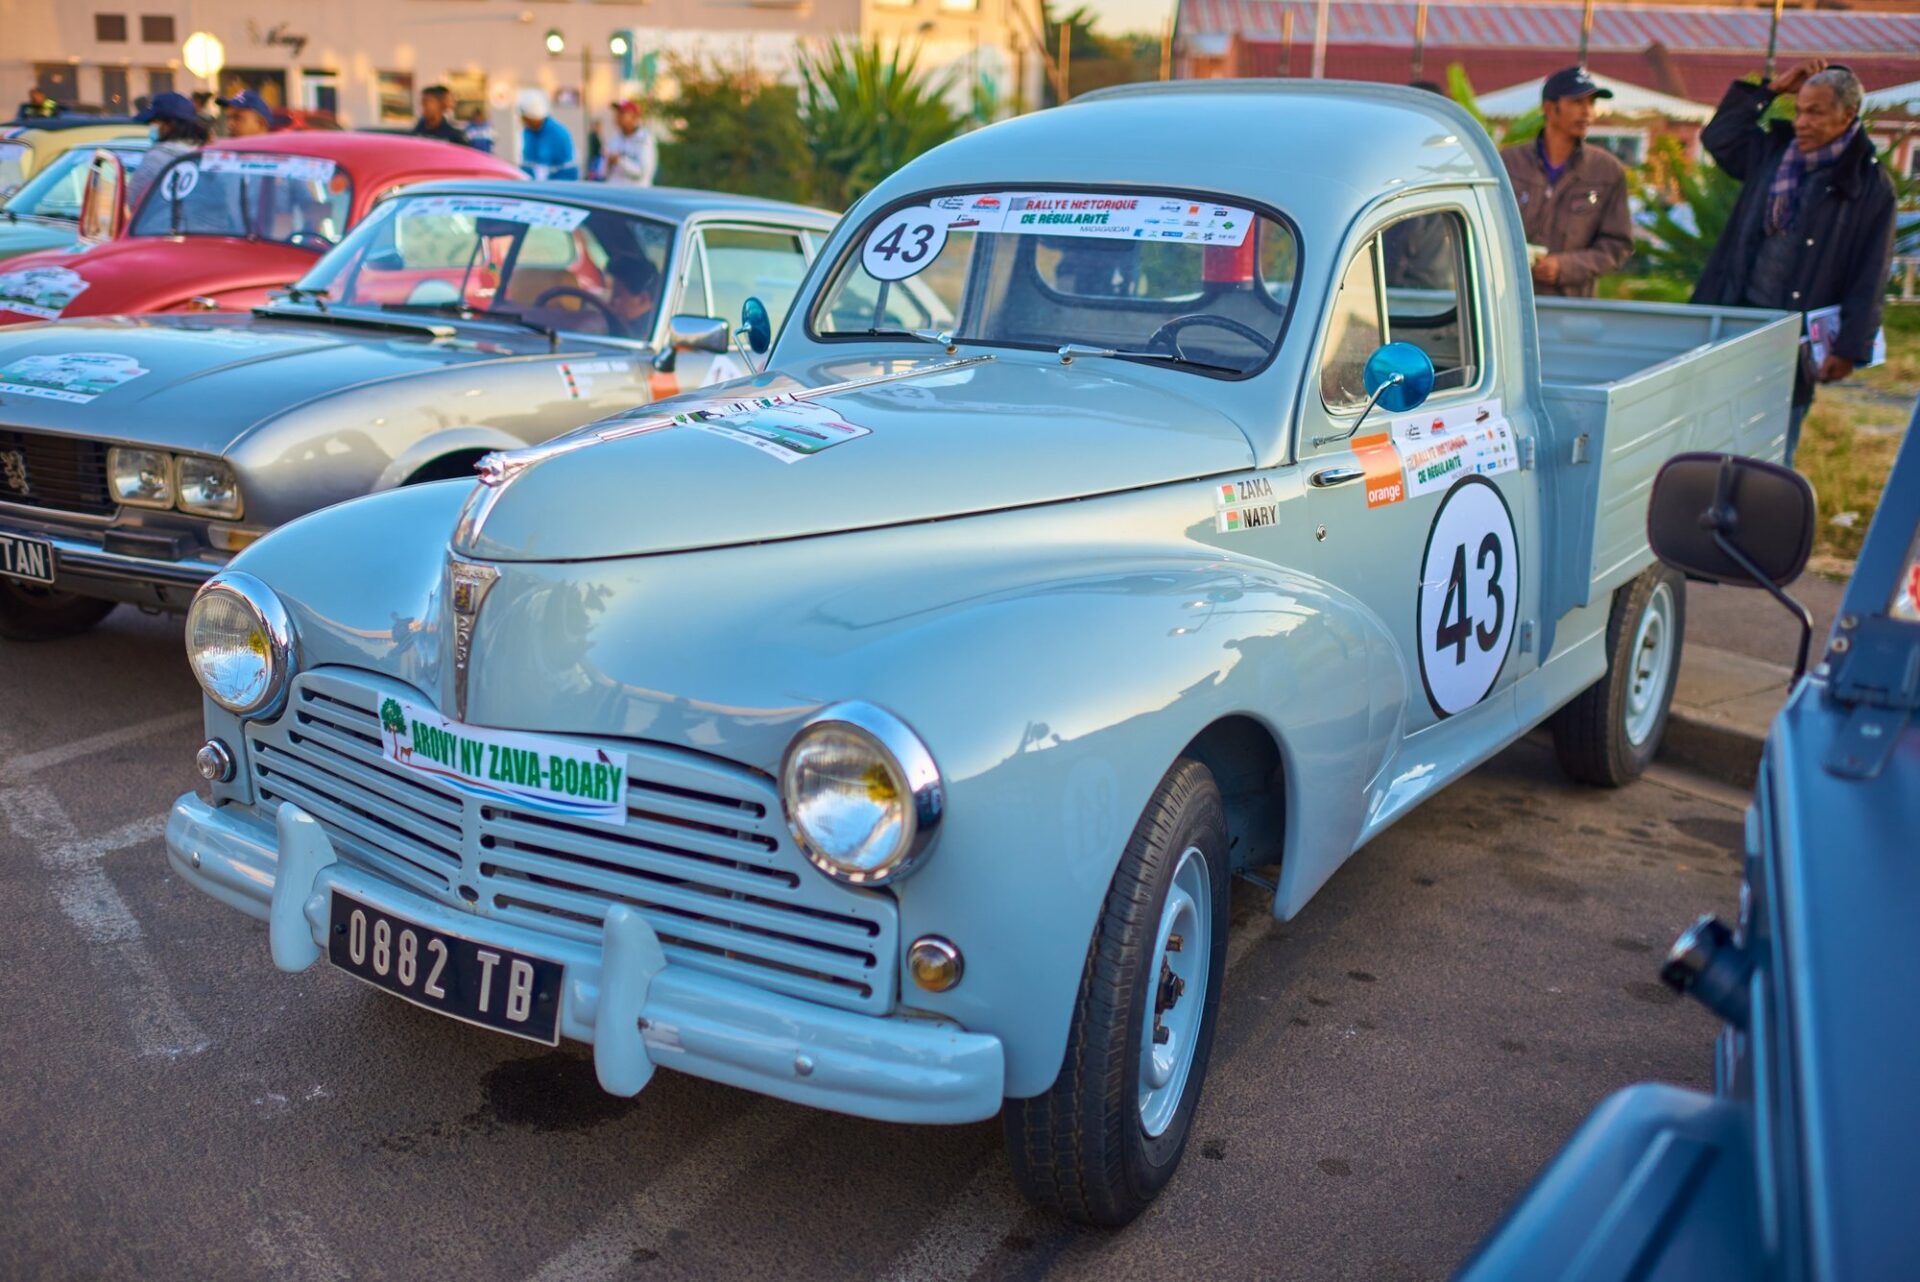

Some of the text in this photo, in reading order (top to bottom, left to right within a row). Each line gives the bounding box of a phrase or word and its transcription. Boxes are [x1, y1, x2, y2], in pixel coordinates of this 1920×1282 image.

[1026, 199, 1138, 210] RALLYE HISTORIQUE
[1020, 210, 1109, 224] DE RÉGULARITÉ
[872, 222, 935, 263] 43
[1418, 469, 1427, 484] DE
[1237, 477, 1273, 500] ZAKA
[1368, 484, 1401, 502] orange
[1243, 505, 1276, 528] NARY
[0, 537, 45, 577] TAN
[1436, 532, 1505, 665] 43
[412, 719, 622, 803] AROVY NY ZAVA-BOARY
[350, 909, 535, 1022] 0882 TB
